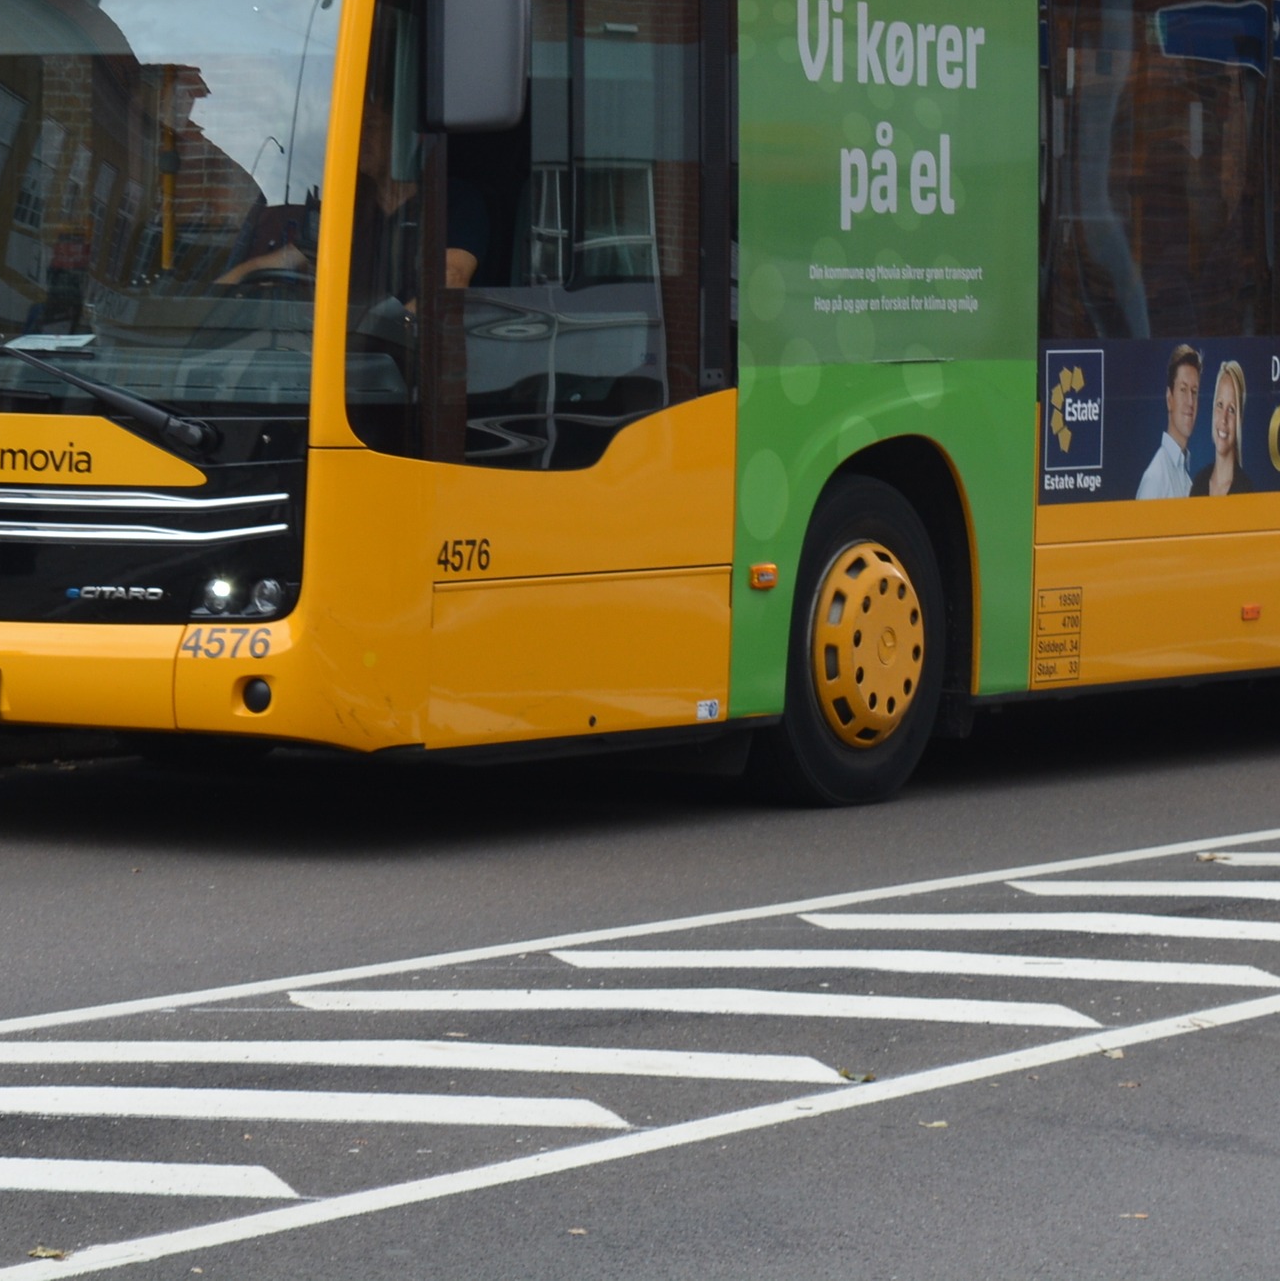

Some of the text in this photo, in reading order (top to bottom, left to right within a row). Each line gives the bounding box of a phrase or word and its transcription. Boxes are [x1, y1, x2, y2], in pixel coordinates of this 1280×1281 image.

[857, 1, 985, 89] kører
[840, 121, 956, 231] på el
[824, 265, 864, 279] kommune
[865, 268, 876, 282] og
[877, 264, 900, 279] Movia
[945, 266, 983, 282] transport
[814, 296, 830, 313] Hop
[832, 294, 842, 313] på
[843, 299, 854, 313] og
[869, 299, 880, 310] en
[881, 295, 909, 310] forskel
[911, 295, 923, 310] for
[924, 295, 946, 310] klima
[947, 299, 957, 313] og
[1065, 397, 1100, 421] Estate
[0, 441, 92, 473] movia
[1044, 473, 1102, 492] Estate Køge
[437, 539, 490, 572] 4576
[181, 628, 272, 659] 4576
[1069, 640, 1078, 652] 34
